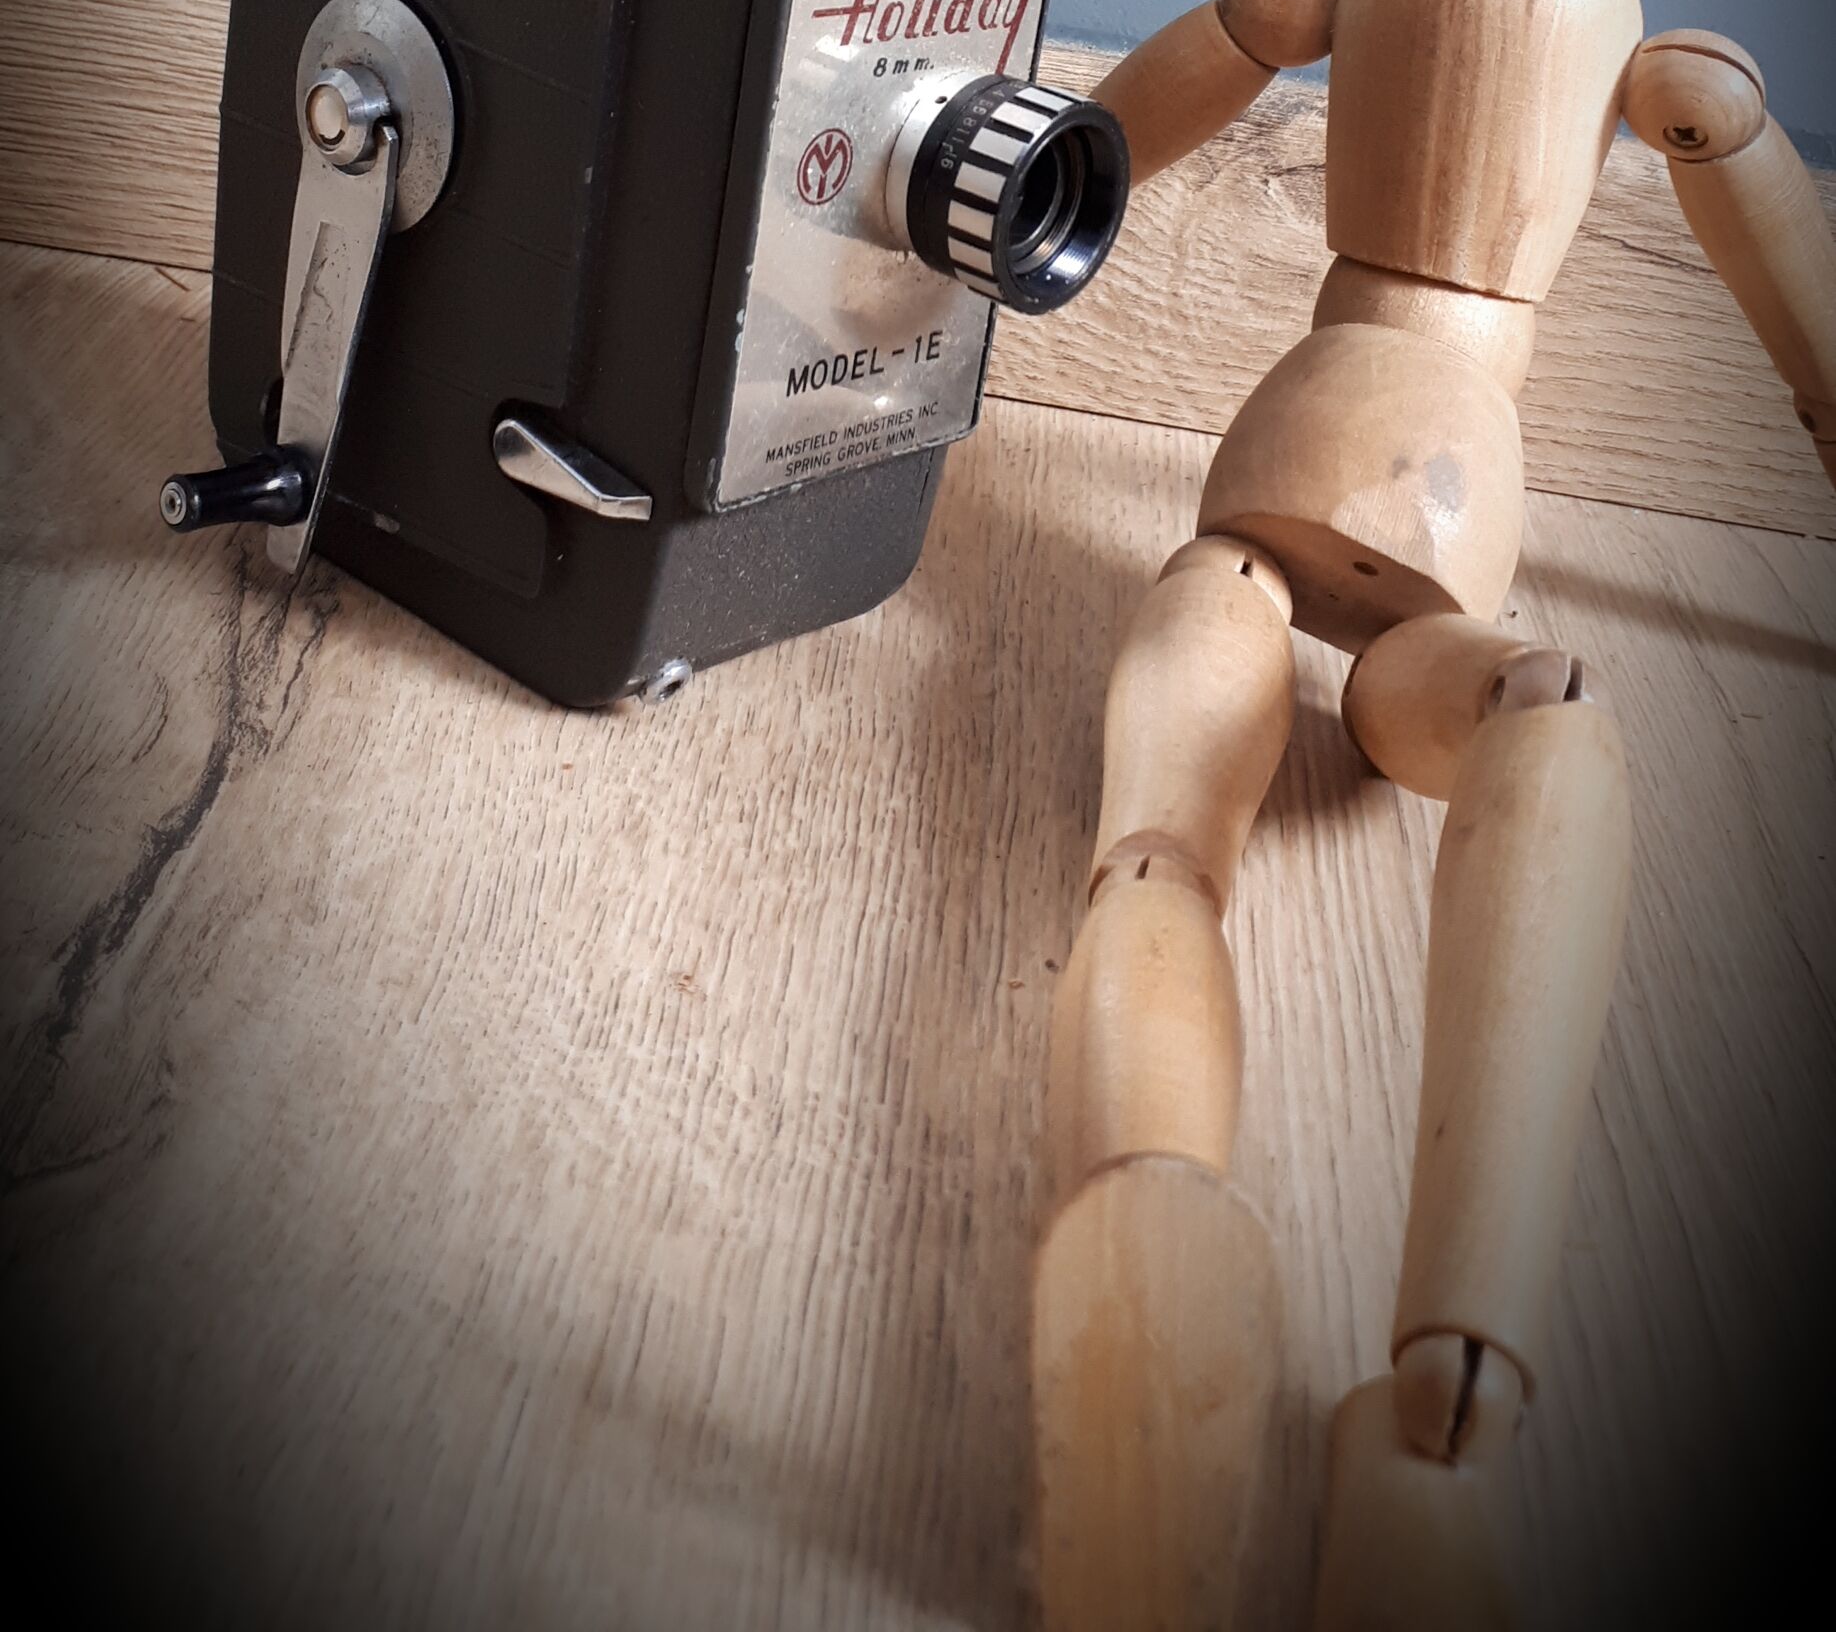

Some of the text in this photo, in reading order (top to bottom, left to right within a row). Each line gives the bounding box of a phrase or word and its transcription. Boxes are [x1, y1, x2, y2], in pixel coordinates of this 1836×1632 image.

[765, 430, 838, 464] MANSFIELD
[843, 408, 914, 441] INDUSTRIES
[784, 452, 831, 478] SPRING
